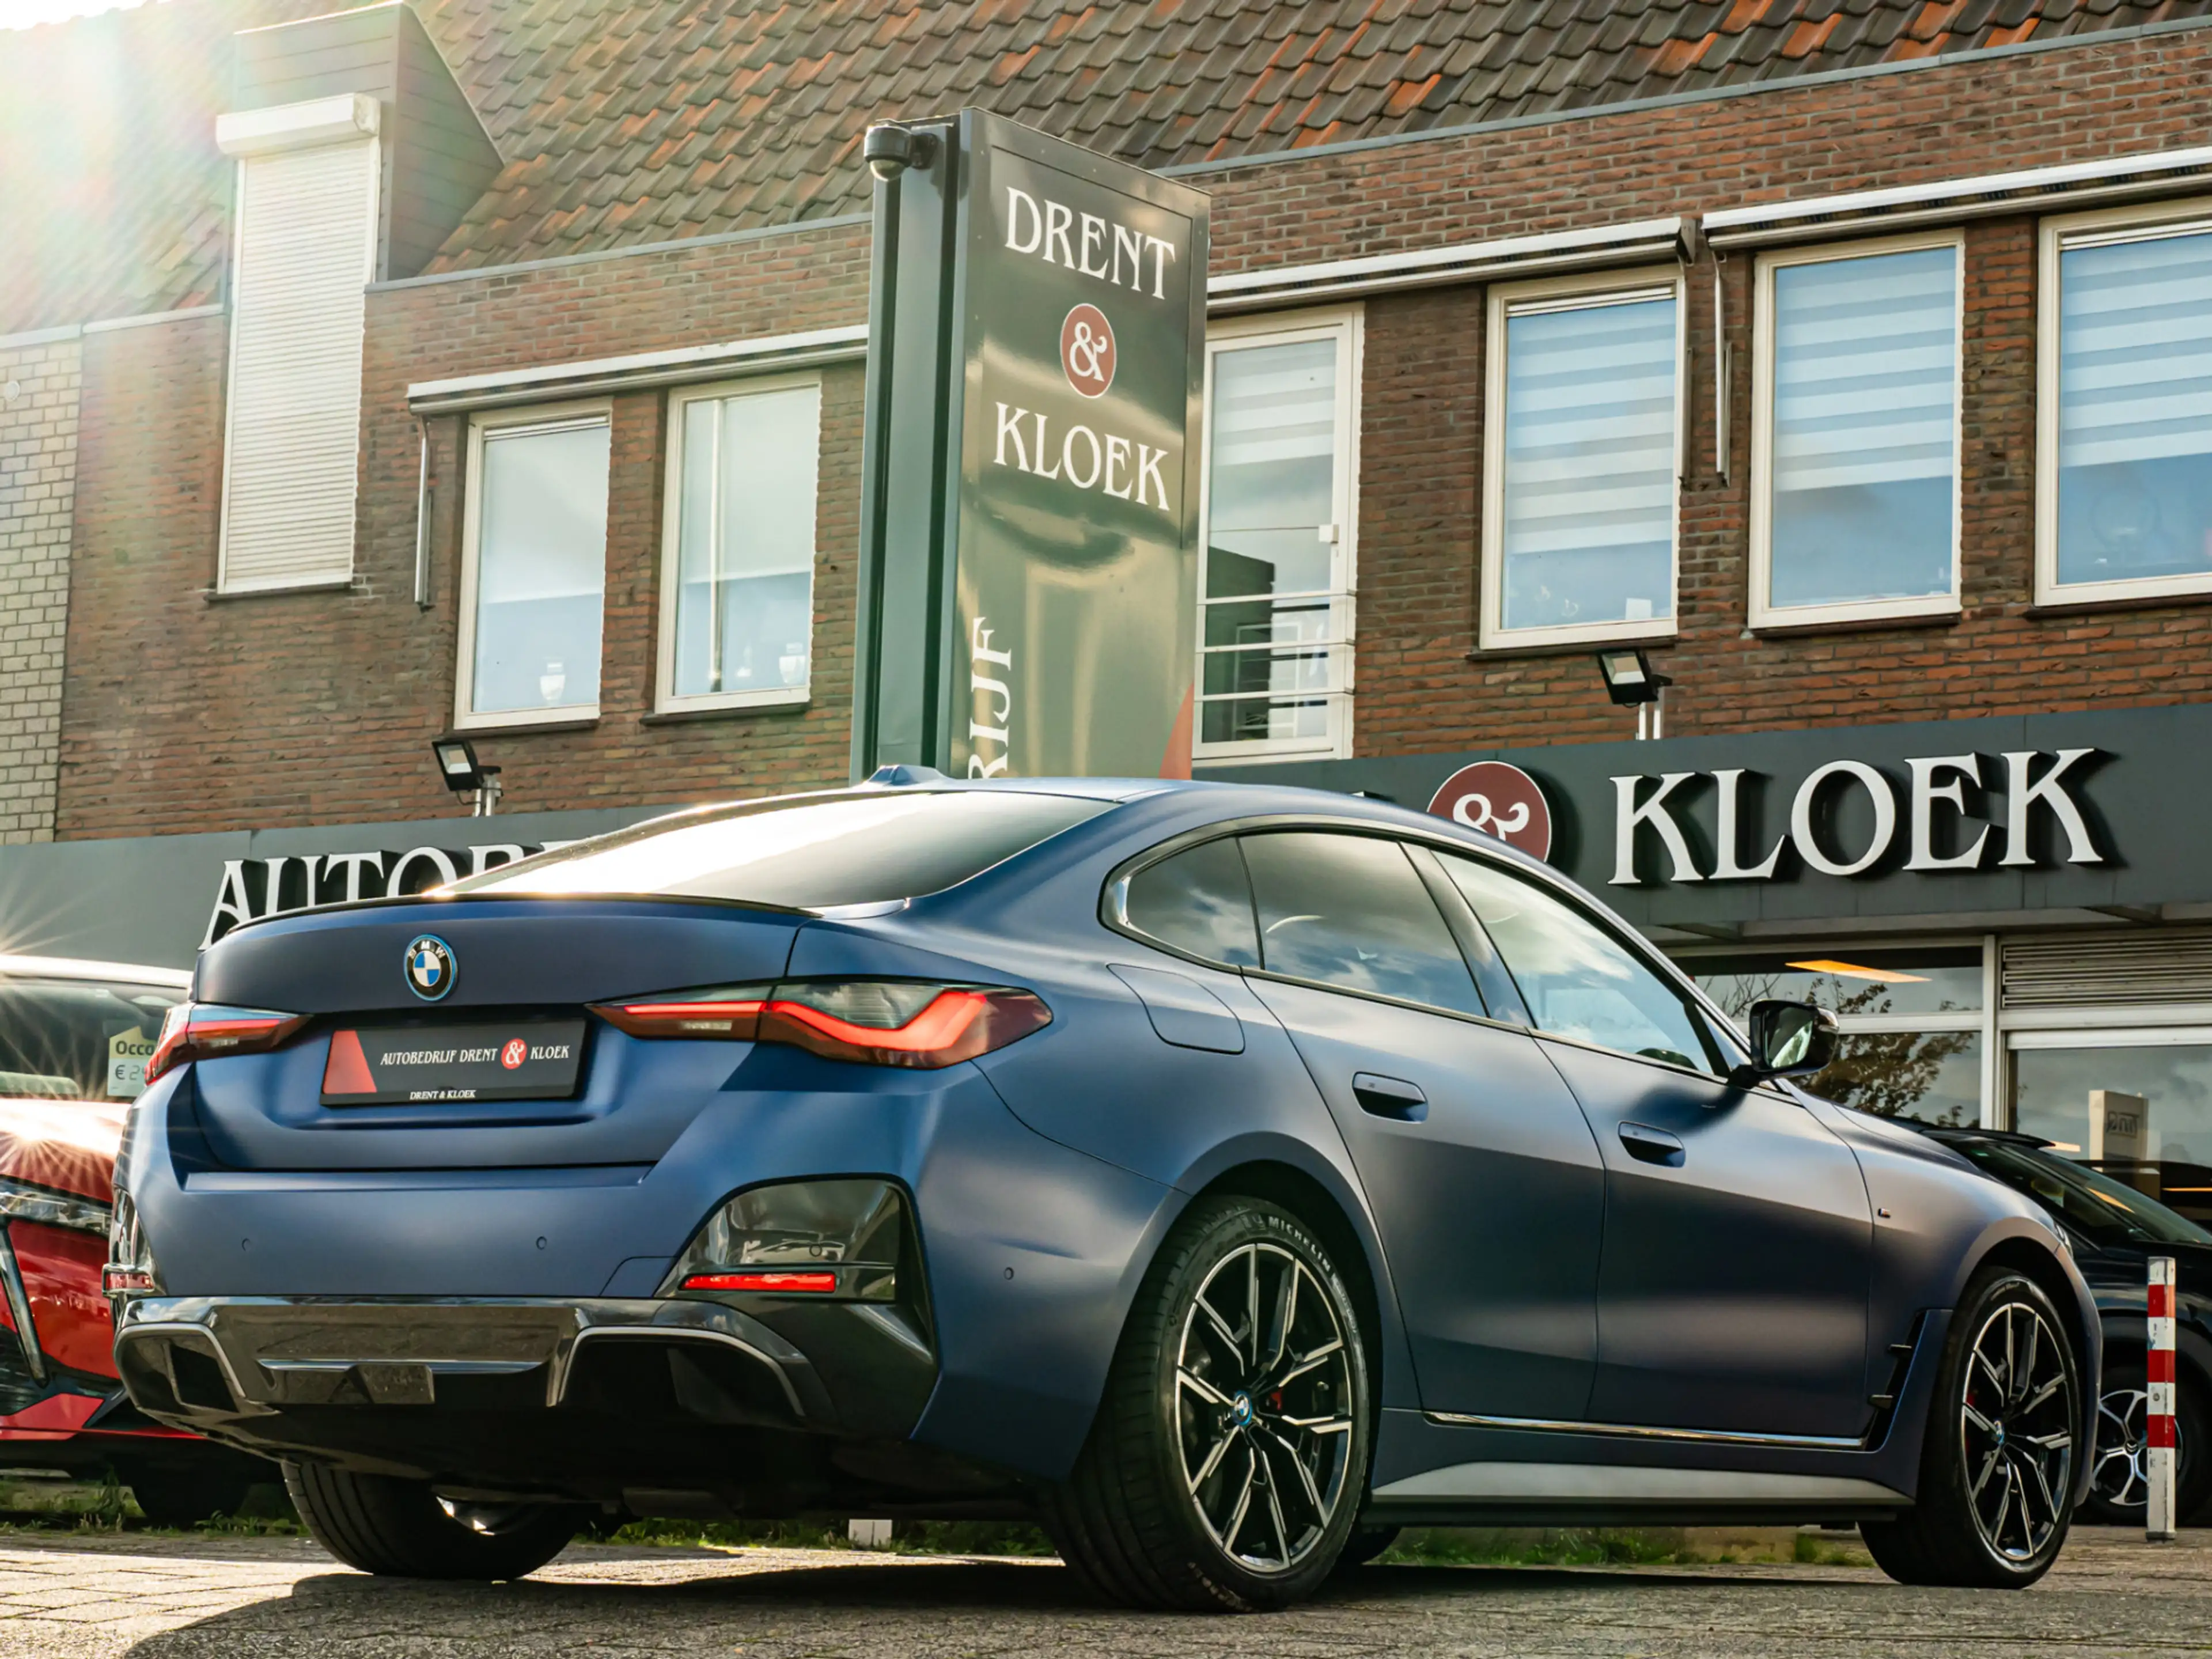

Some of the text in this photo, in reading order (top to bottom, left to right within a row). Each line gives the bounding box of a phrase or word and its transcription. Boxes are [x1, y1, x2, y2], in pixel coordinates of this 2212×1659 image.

[1005, 187, 1176, 300] DRENT
[1069, 321, 1107, 382] &
[994, 402, 1171, 511] KLOEK
[1607, 748, 2104, 885] KLOEK
[197, 839, 585, 951] AUTO
[380, 1041, 570, 1066] AUTOBEDRIJF DRENT & KLOEK
[410, 1089, 476, 1100] DRENT & KLOEK
[1268, 1216, 1331, 1272] MICHELIN
